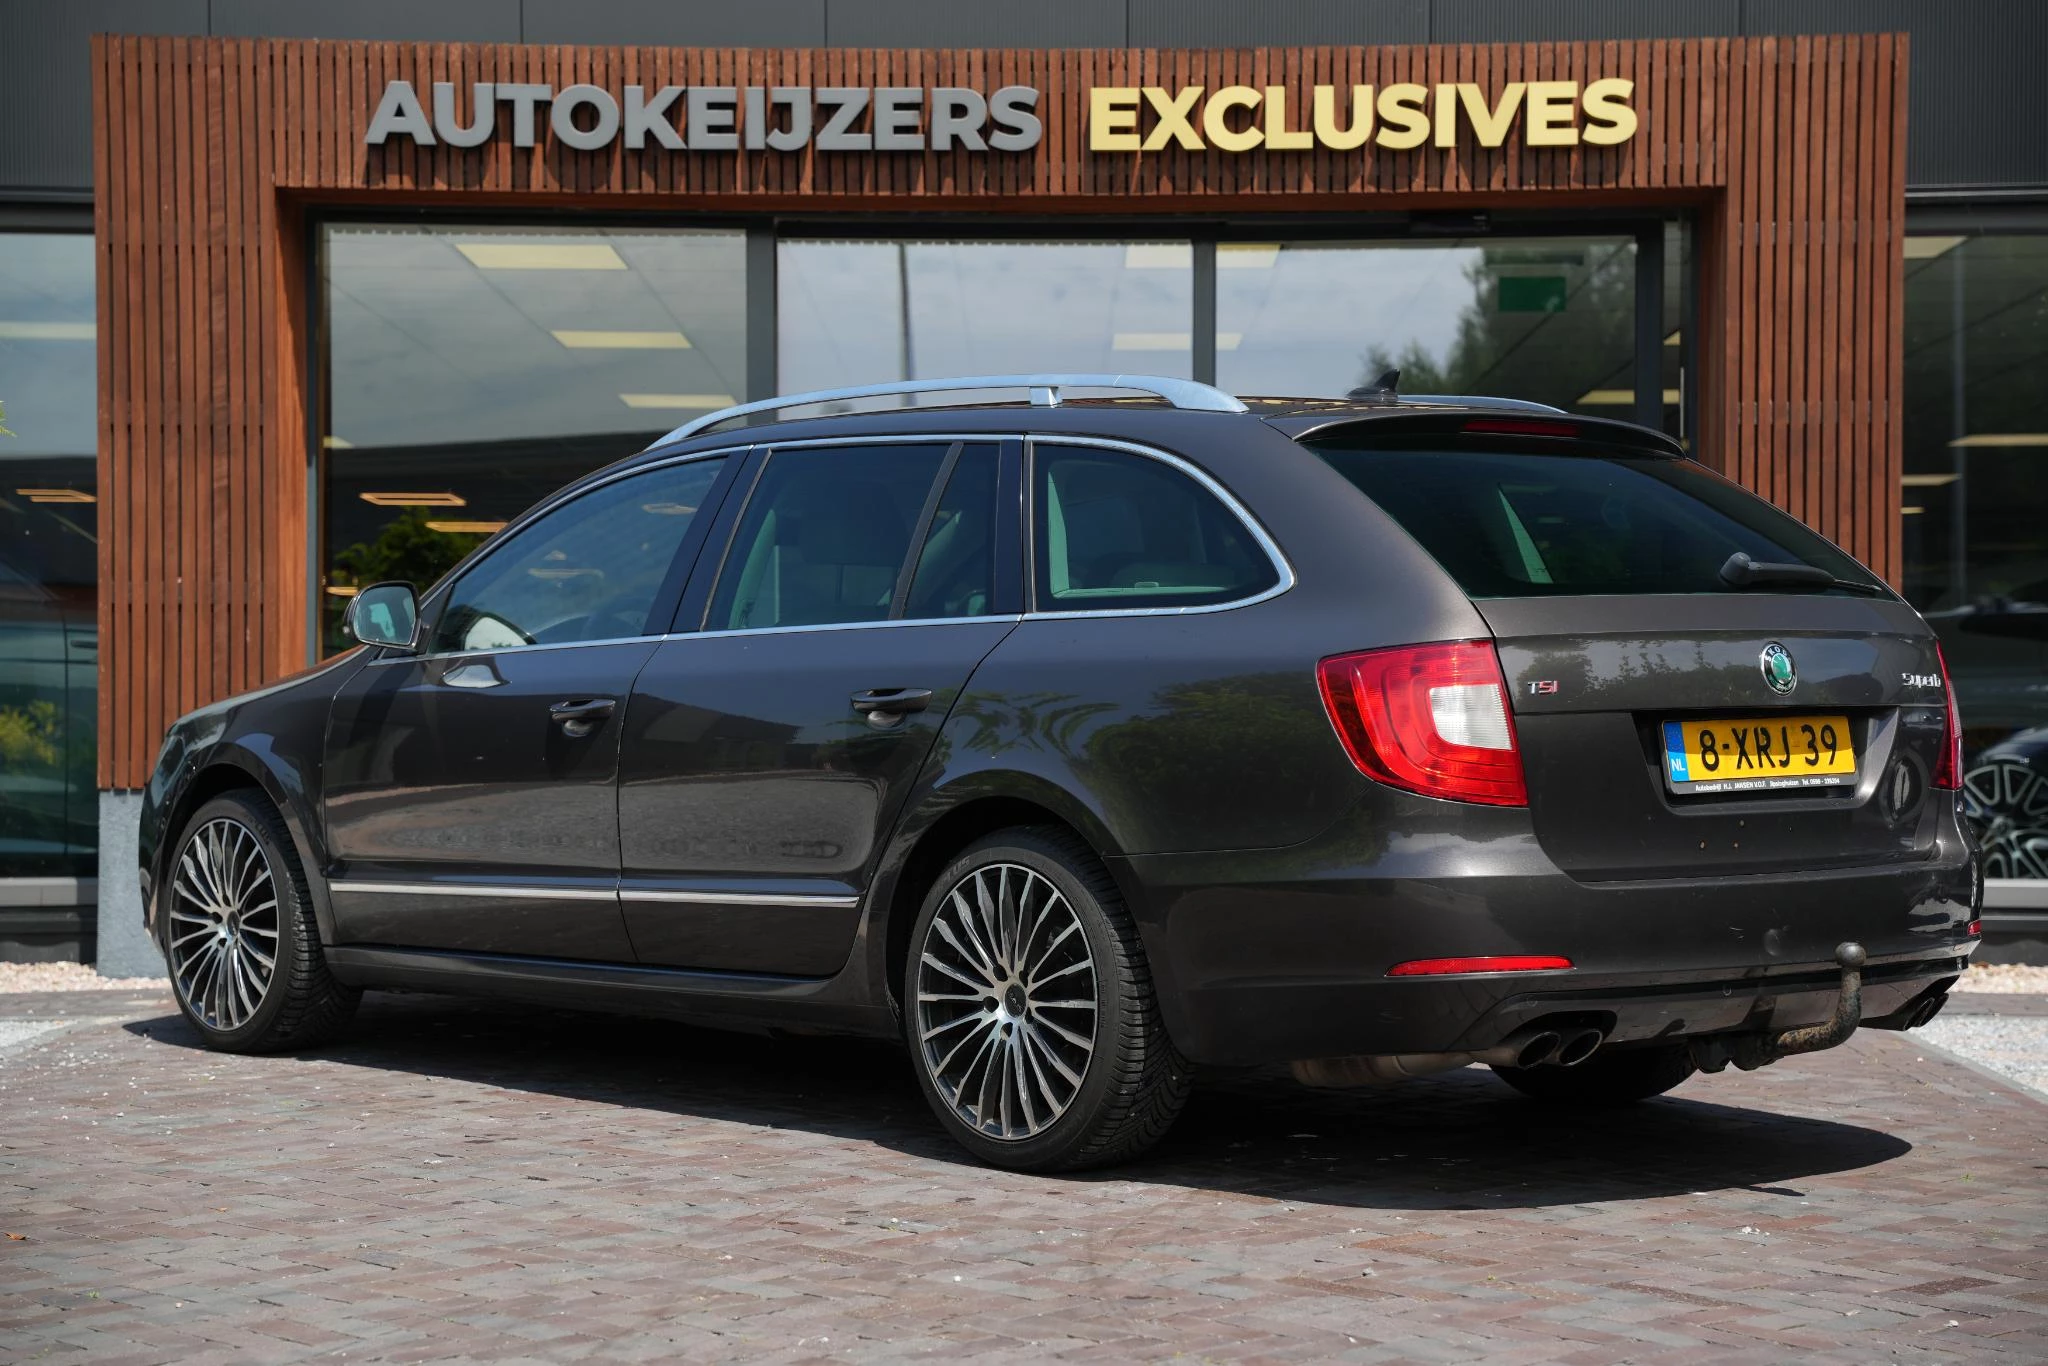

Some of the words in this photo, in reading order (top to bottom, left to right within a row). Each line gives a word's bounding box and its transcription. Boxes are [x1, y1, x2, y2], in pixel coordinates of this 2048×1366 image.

[364, 80, 1043, 152] AUTOKEIJZERS
[1089, 77, 1638, 152] EXCLUSIVES
[1527, 680, 1558, 694] TSI
[1901, 672, 1941, 689] Superb
[1670, 758, 1686, 772] NL
